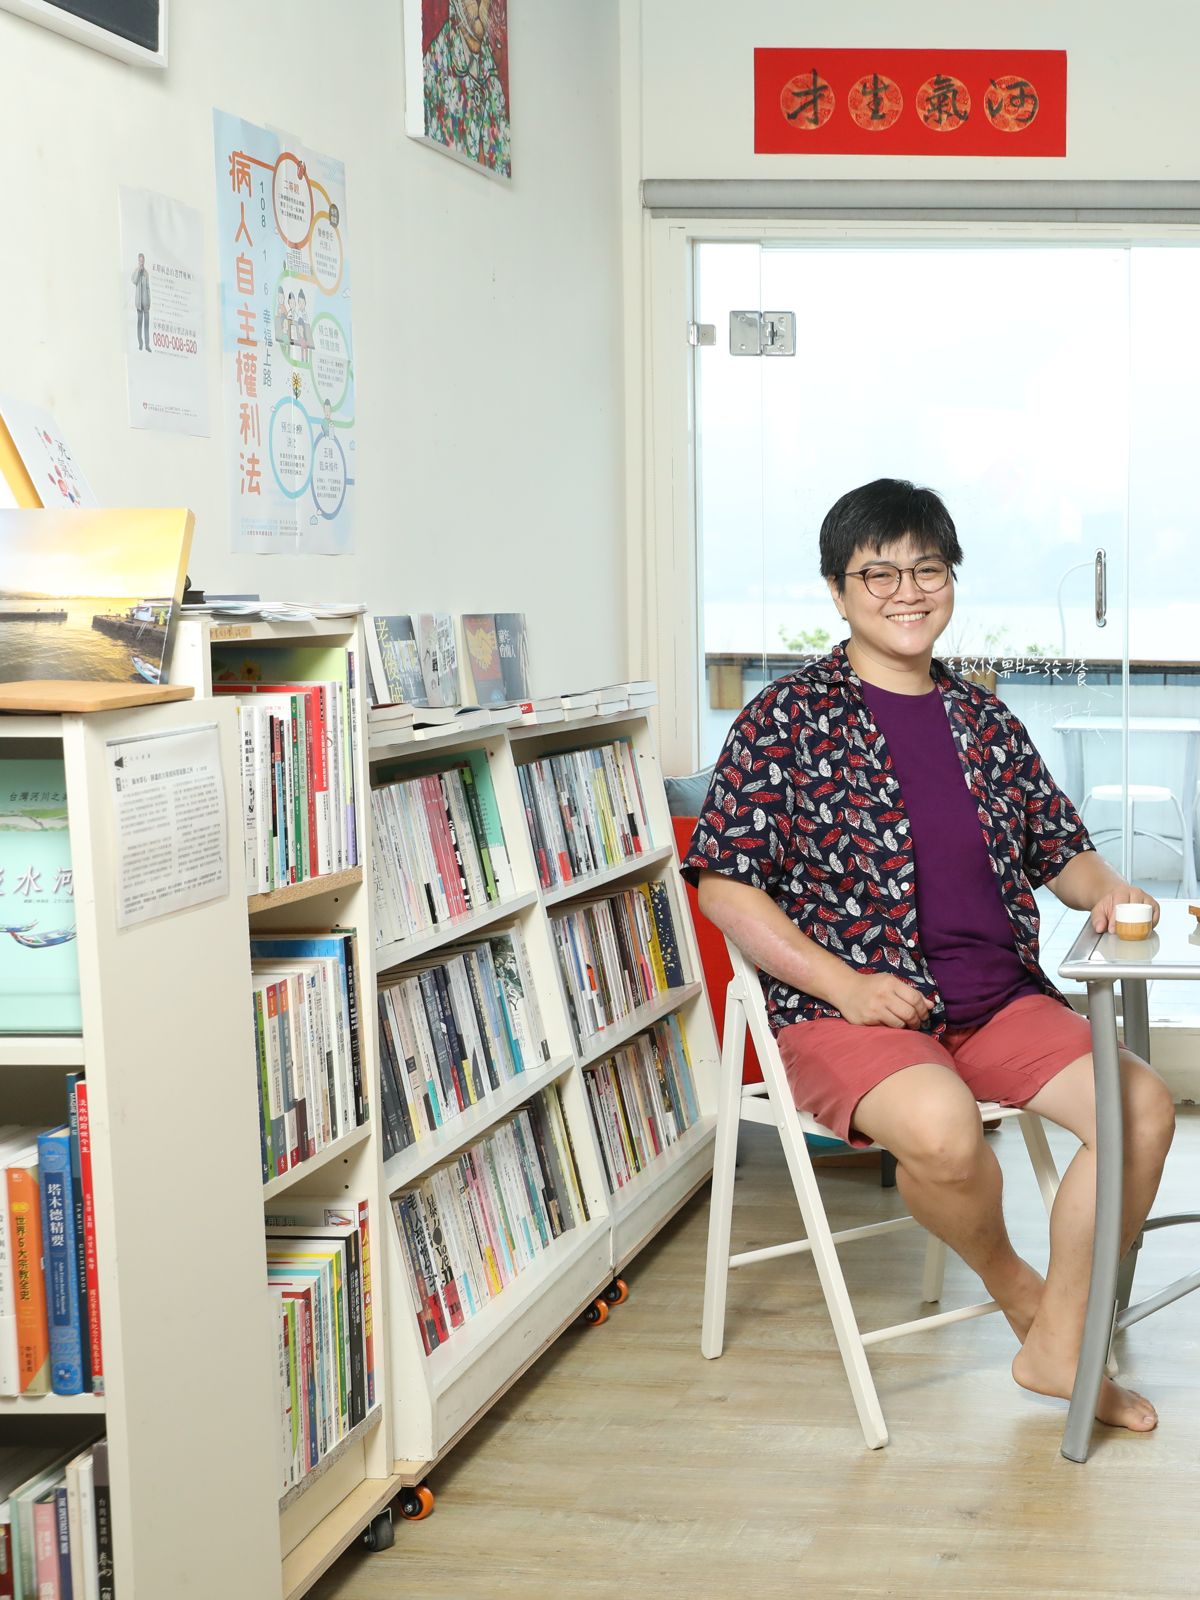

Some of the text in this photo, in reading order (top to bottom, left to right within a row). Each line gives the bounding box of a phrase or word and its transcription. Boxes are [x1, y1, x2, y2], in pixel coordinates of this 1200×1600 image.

[259, 181, 267, 228] 108
[153, 332, 197, 354] 0800-008-520
[229, 150, 262, 496] 病人自主權利法
[262, 309, 274, 387] 幸福上路
[48, 1183, 66, 1248] 塔木德精要
